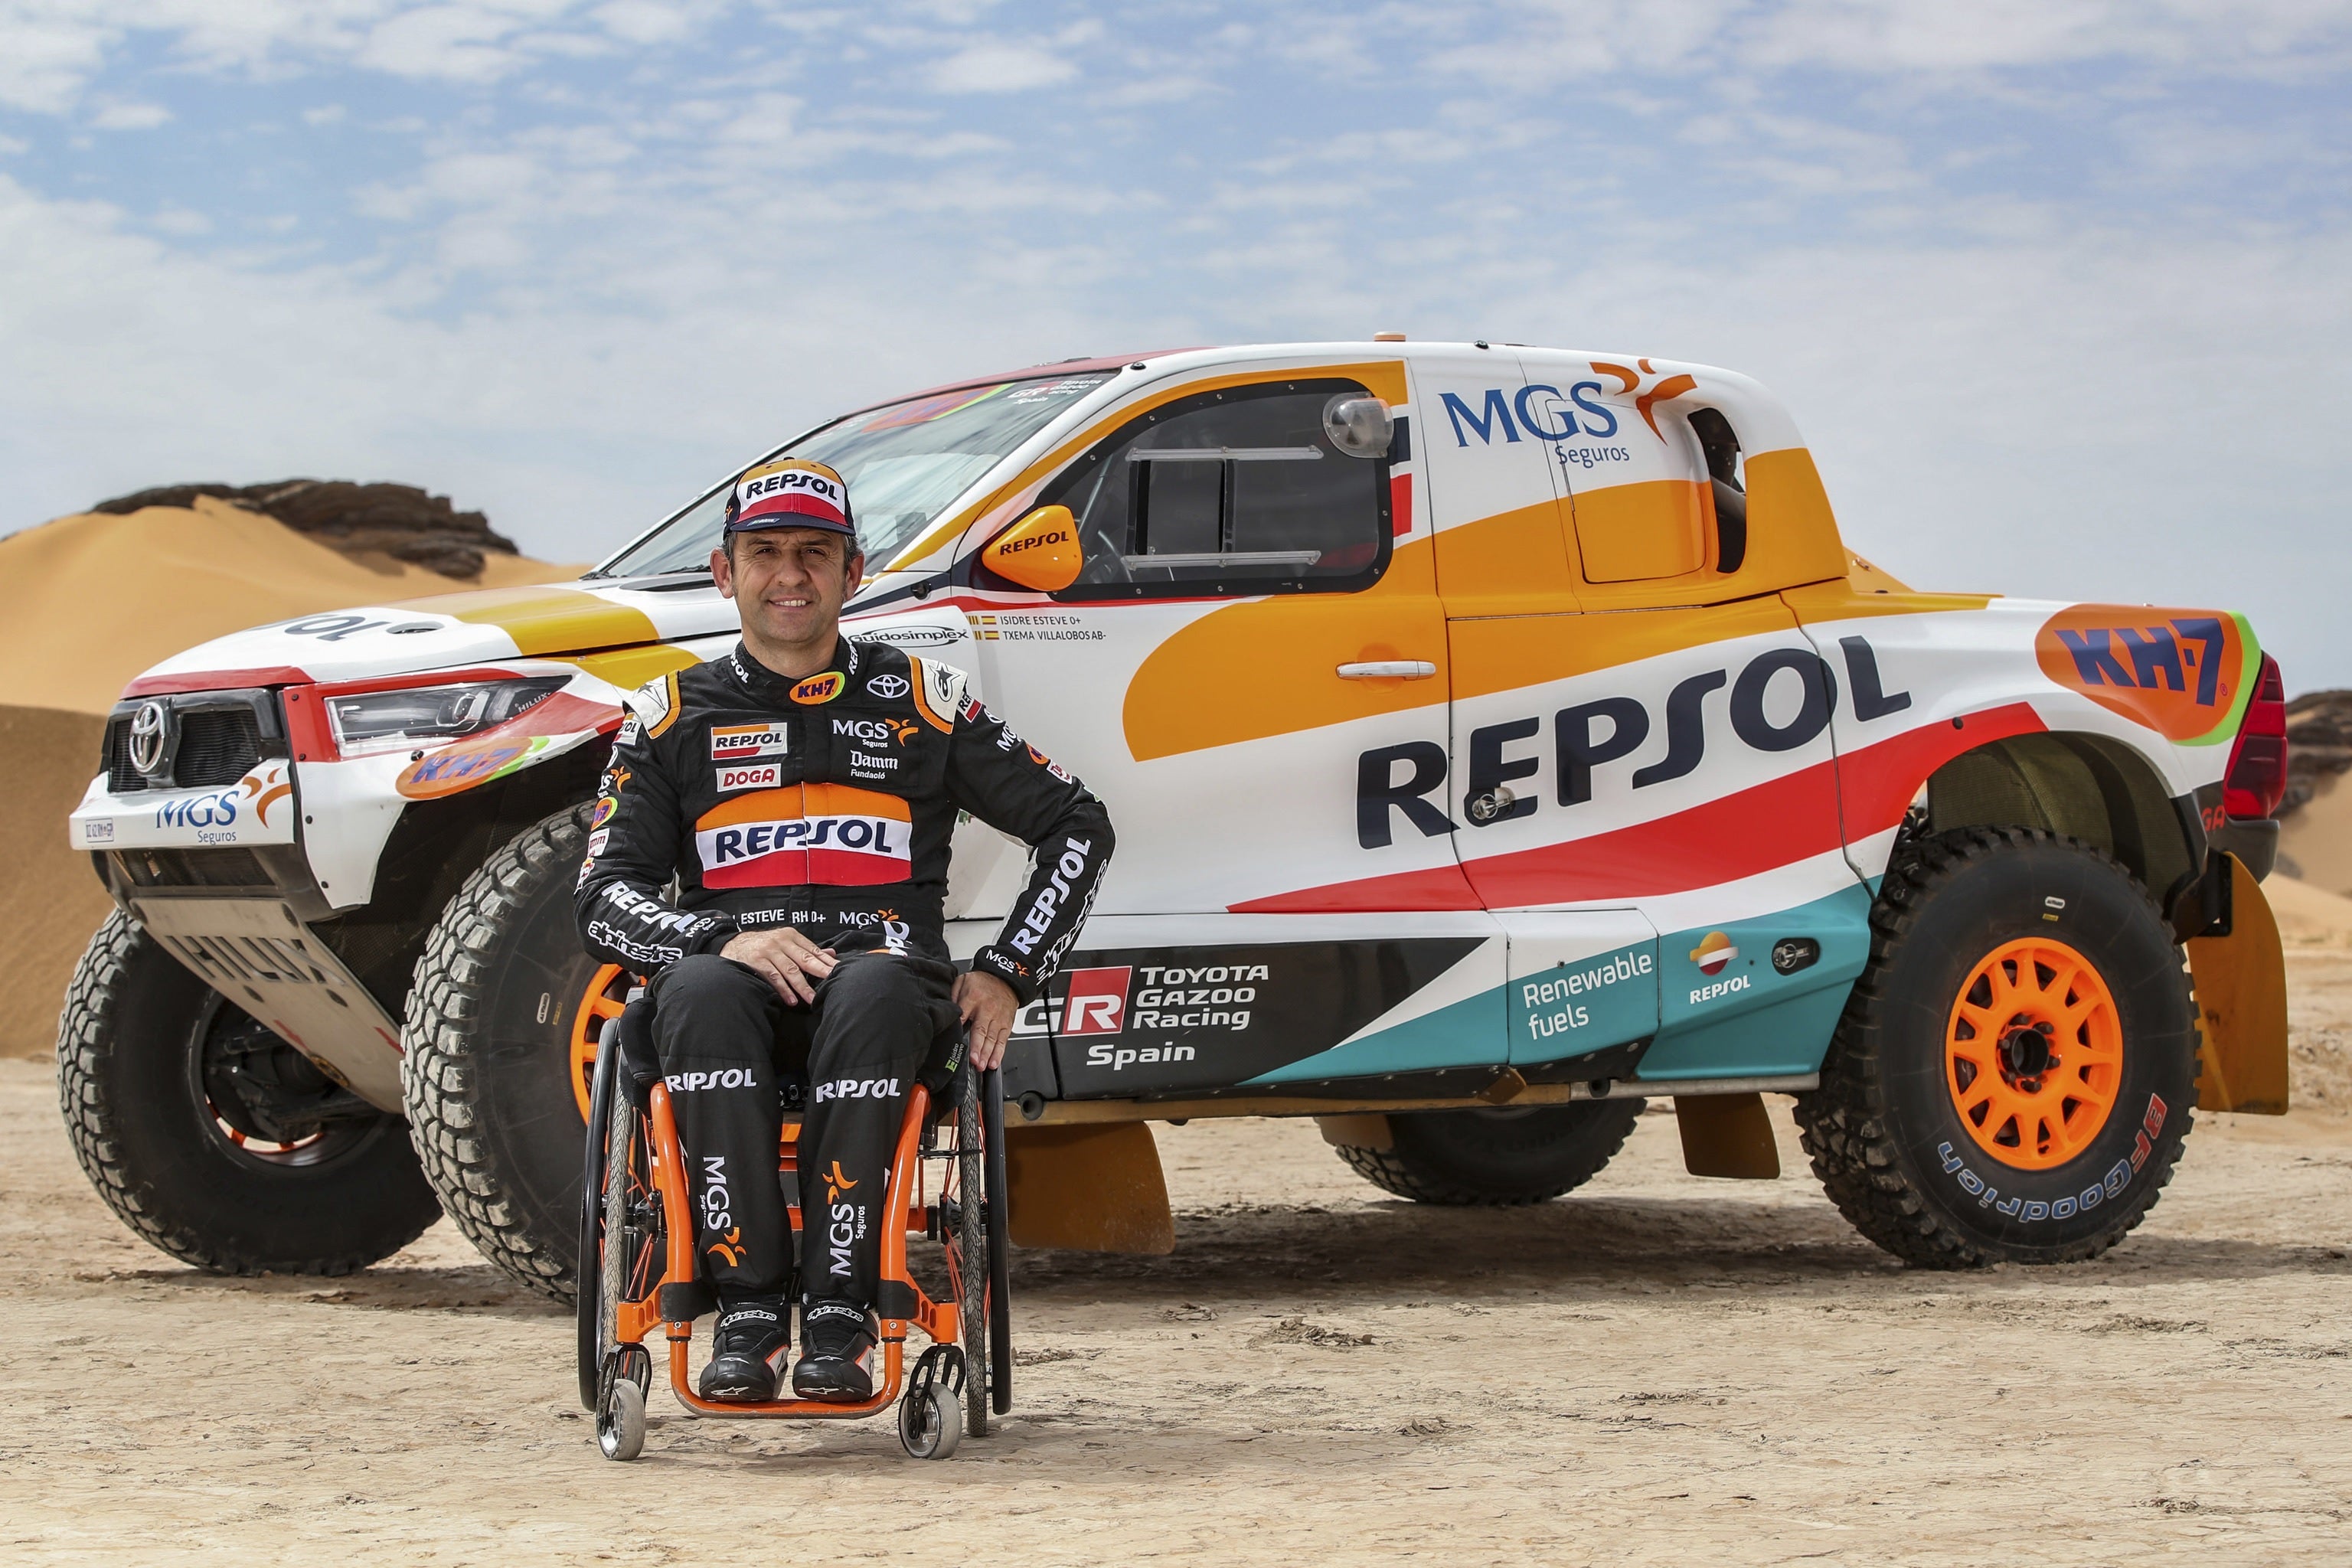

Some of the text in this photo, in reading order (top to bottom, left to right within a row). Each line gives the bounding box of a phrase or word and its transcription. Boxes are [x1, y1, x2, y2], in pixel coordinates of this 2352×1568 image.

[1438, 382, 1619, 448] MGS
[1554, 445, 1630, 469] Seguros
[746, 474, 838, 500] REPSOL
[1000, 531, 1069, 555] REPSOL
[1000, 616, 1031, 625] ISIDRE
[1034, 616, 1067, 625] ESTEVE
[848, 629, 969, 643] Guidosimplex
[1003, 631, 1034, 640] TXEMA
[1037, 631, 1091, 640] VILLALOBOS
[2053, 618, 2225, 707] KH-7
[797, 678, 836, 698] KH-7
[518, 692, 552, 714] HILUX
[715, 732, 783, 748] REPSOL
[832, 719, 889, 739] MGS
[862, 739, 888, 748] Seguros
[1357, 635, 1912, 851] REPSOL
[850, 750, 898, 769] Damm
[723, 769, 776, 787] DOGA
[851, 768, 886, 779] Fundació
[155, 790, 239, 829] MGS
[198, 830, 237, 845] Seguros
[716, 819, 892, 864] REPSOL
[1010, 837, 1091, 956] REPSOL
[740, 909, 785, 924] ESTEVE
[985, 949, 1015, 969] MGS
[1140, 965, 1269, 985] TOYOTA
[1523, 952, 1652, 1008] Renewable
[1136, 988, 1256, 1008] GAZOO
[1690, 975, 1751, 1004] REPSOL
[1011, 994, 1122, 1034] GR
[1132, 1008, 1250, 1031] Racing
[1528, 1004, 1589, 1040] fuels
[1086, 1041, 1195, 1071] Spain
[816, 1078, 901, 1103] RPSOL
[1937, 1093, 2167, 1223] BFGoodrich
[703, 1156, 731, 1230] MGS
[855, 1205, 867, 1240] Seguros
[829, 1204, 854, 1277] MGS
